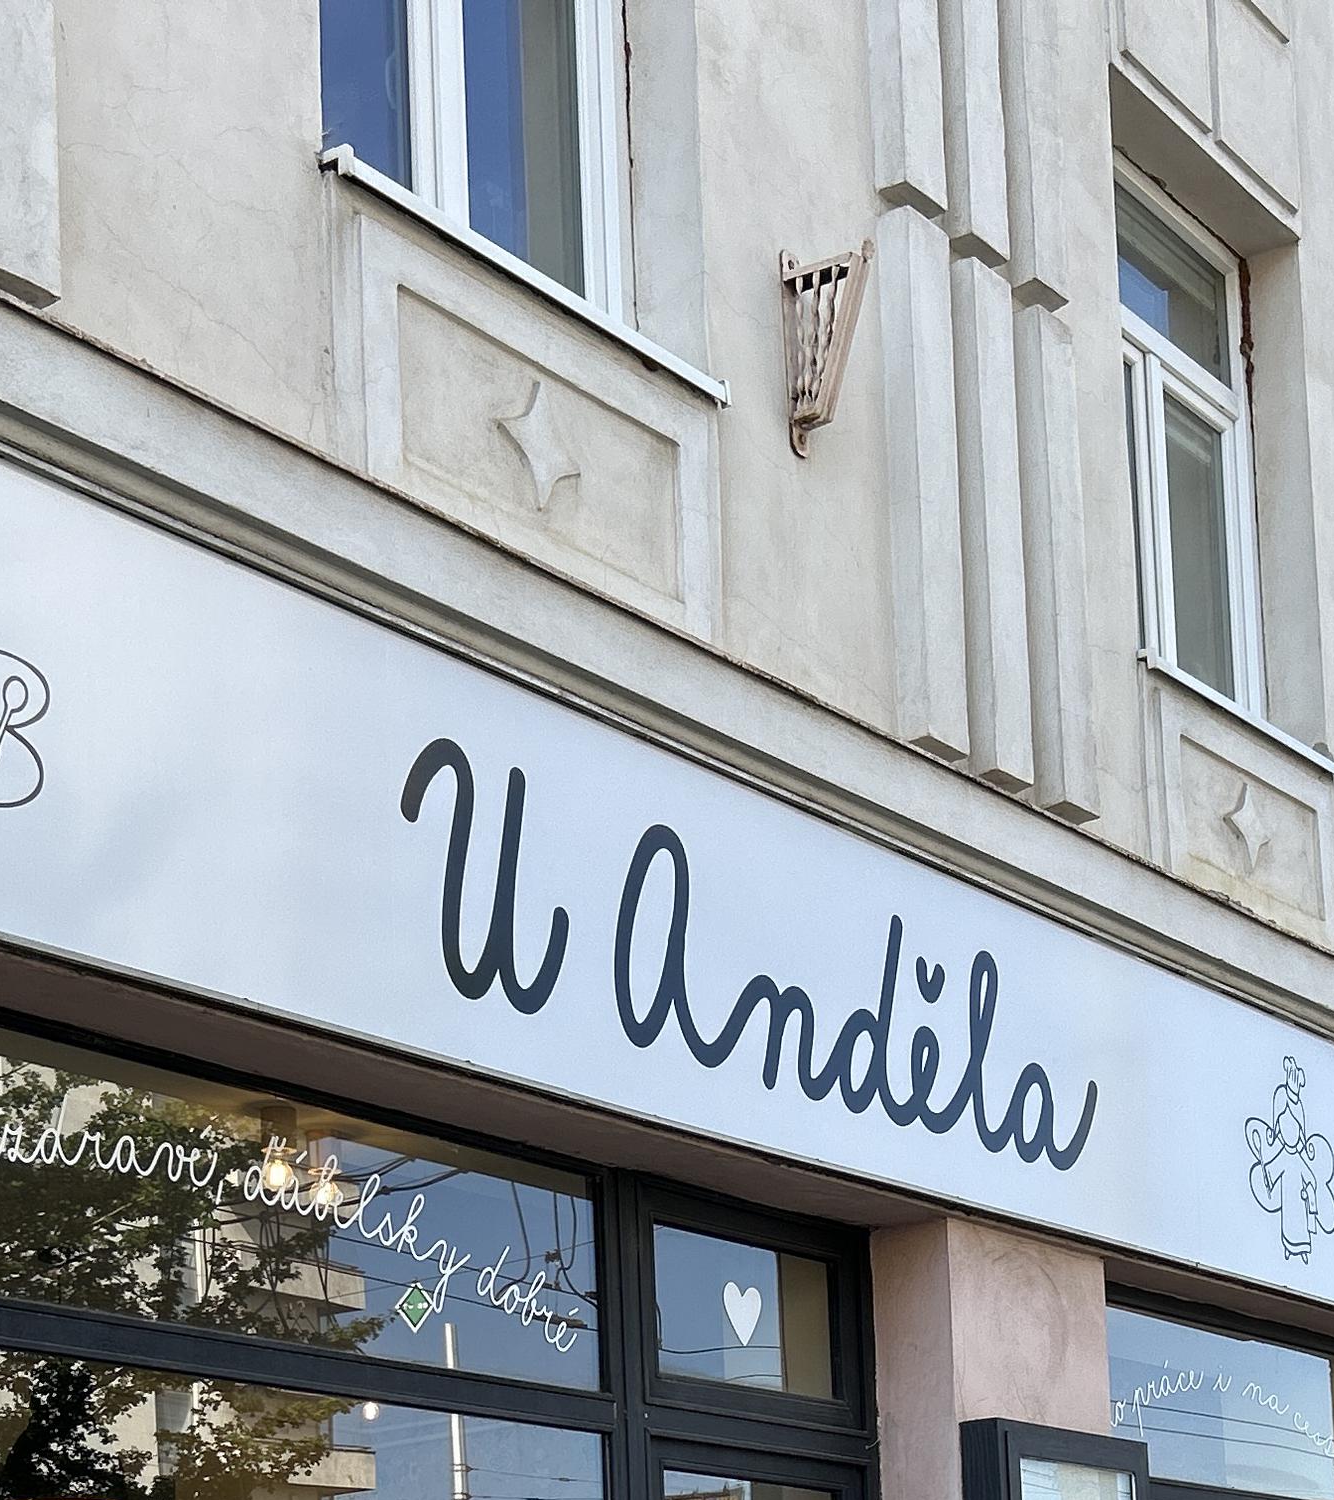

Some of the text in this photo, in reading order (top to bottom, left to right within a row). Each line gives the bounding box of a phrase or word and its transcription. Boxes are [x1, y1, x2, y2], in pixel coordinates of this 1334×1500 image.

[400, 737, 1098, 1171] U Anděla
[476, 1246, 579, 1352] dobré
[1132, 1360, 1204, 1437] práce
[1213, 1365, 1232, 1392] i
[1242, 1382, 1290, 1416] na
